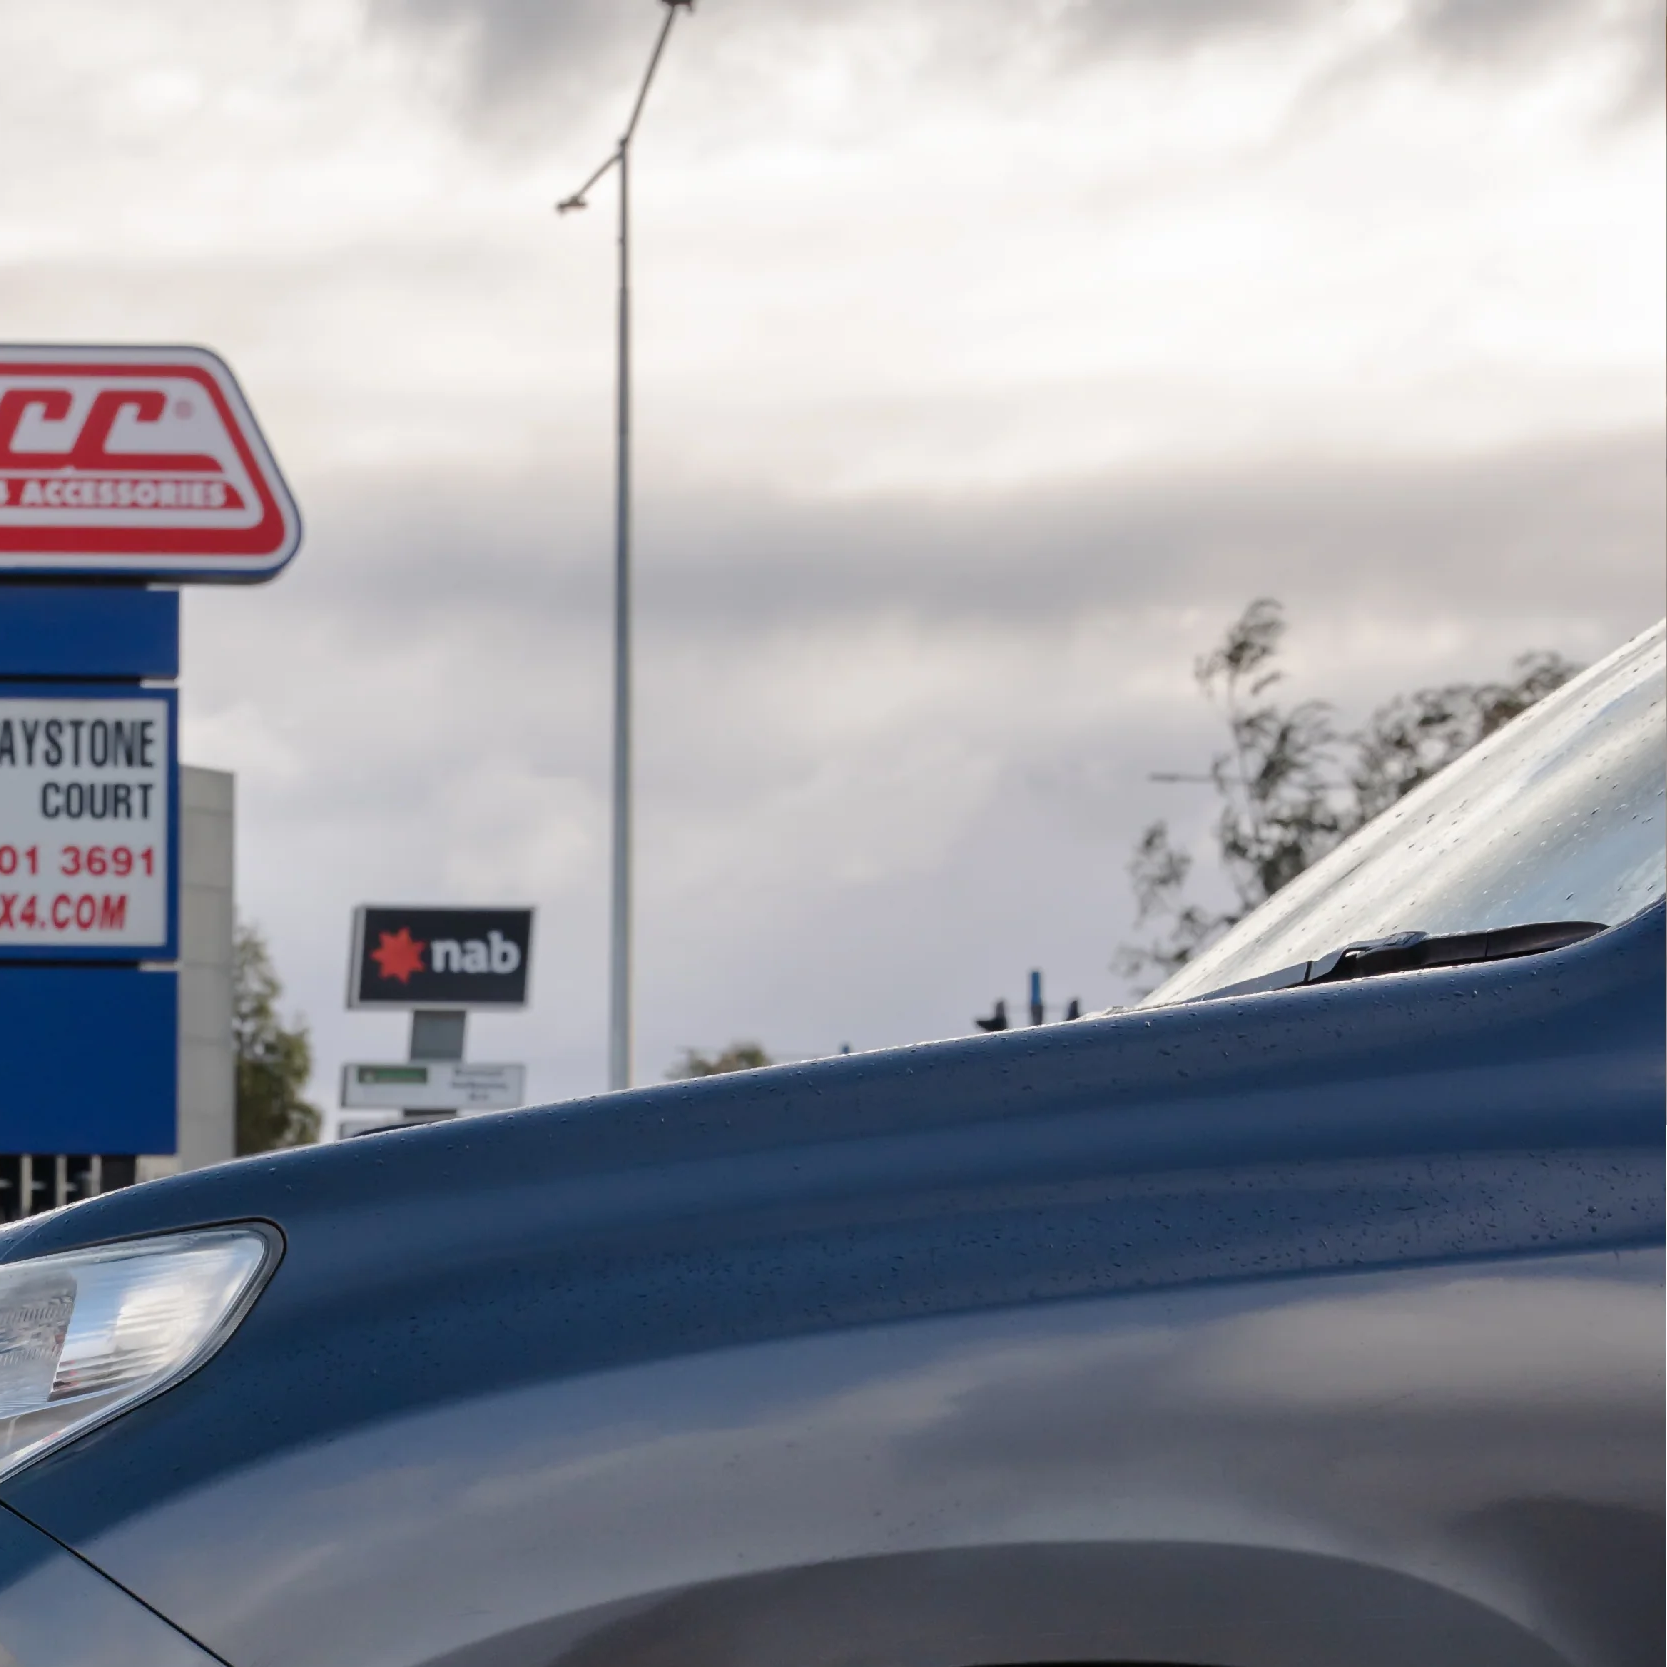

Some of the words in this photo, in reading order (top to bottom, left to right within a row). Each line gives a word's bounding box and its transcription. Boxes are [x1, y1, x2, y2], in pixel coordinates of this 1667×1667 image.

[20, 479, 227, 509] ACCESSORIES
[41, 782, 153, 820] COURT
[60, 846, 155, 877] 3691
[430, 930, 522, 974] nab
